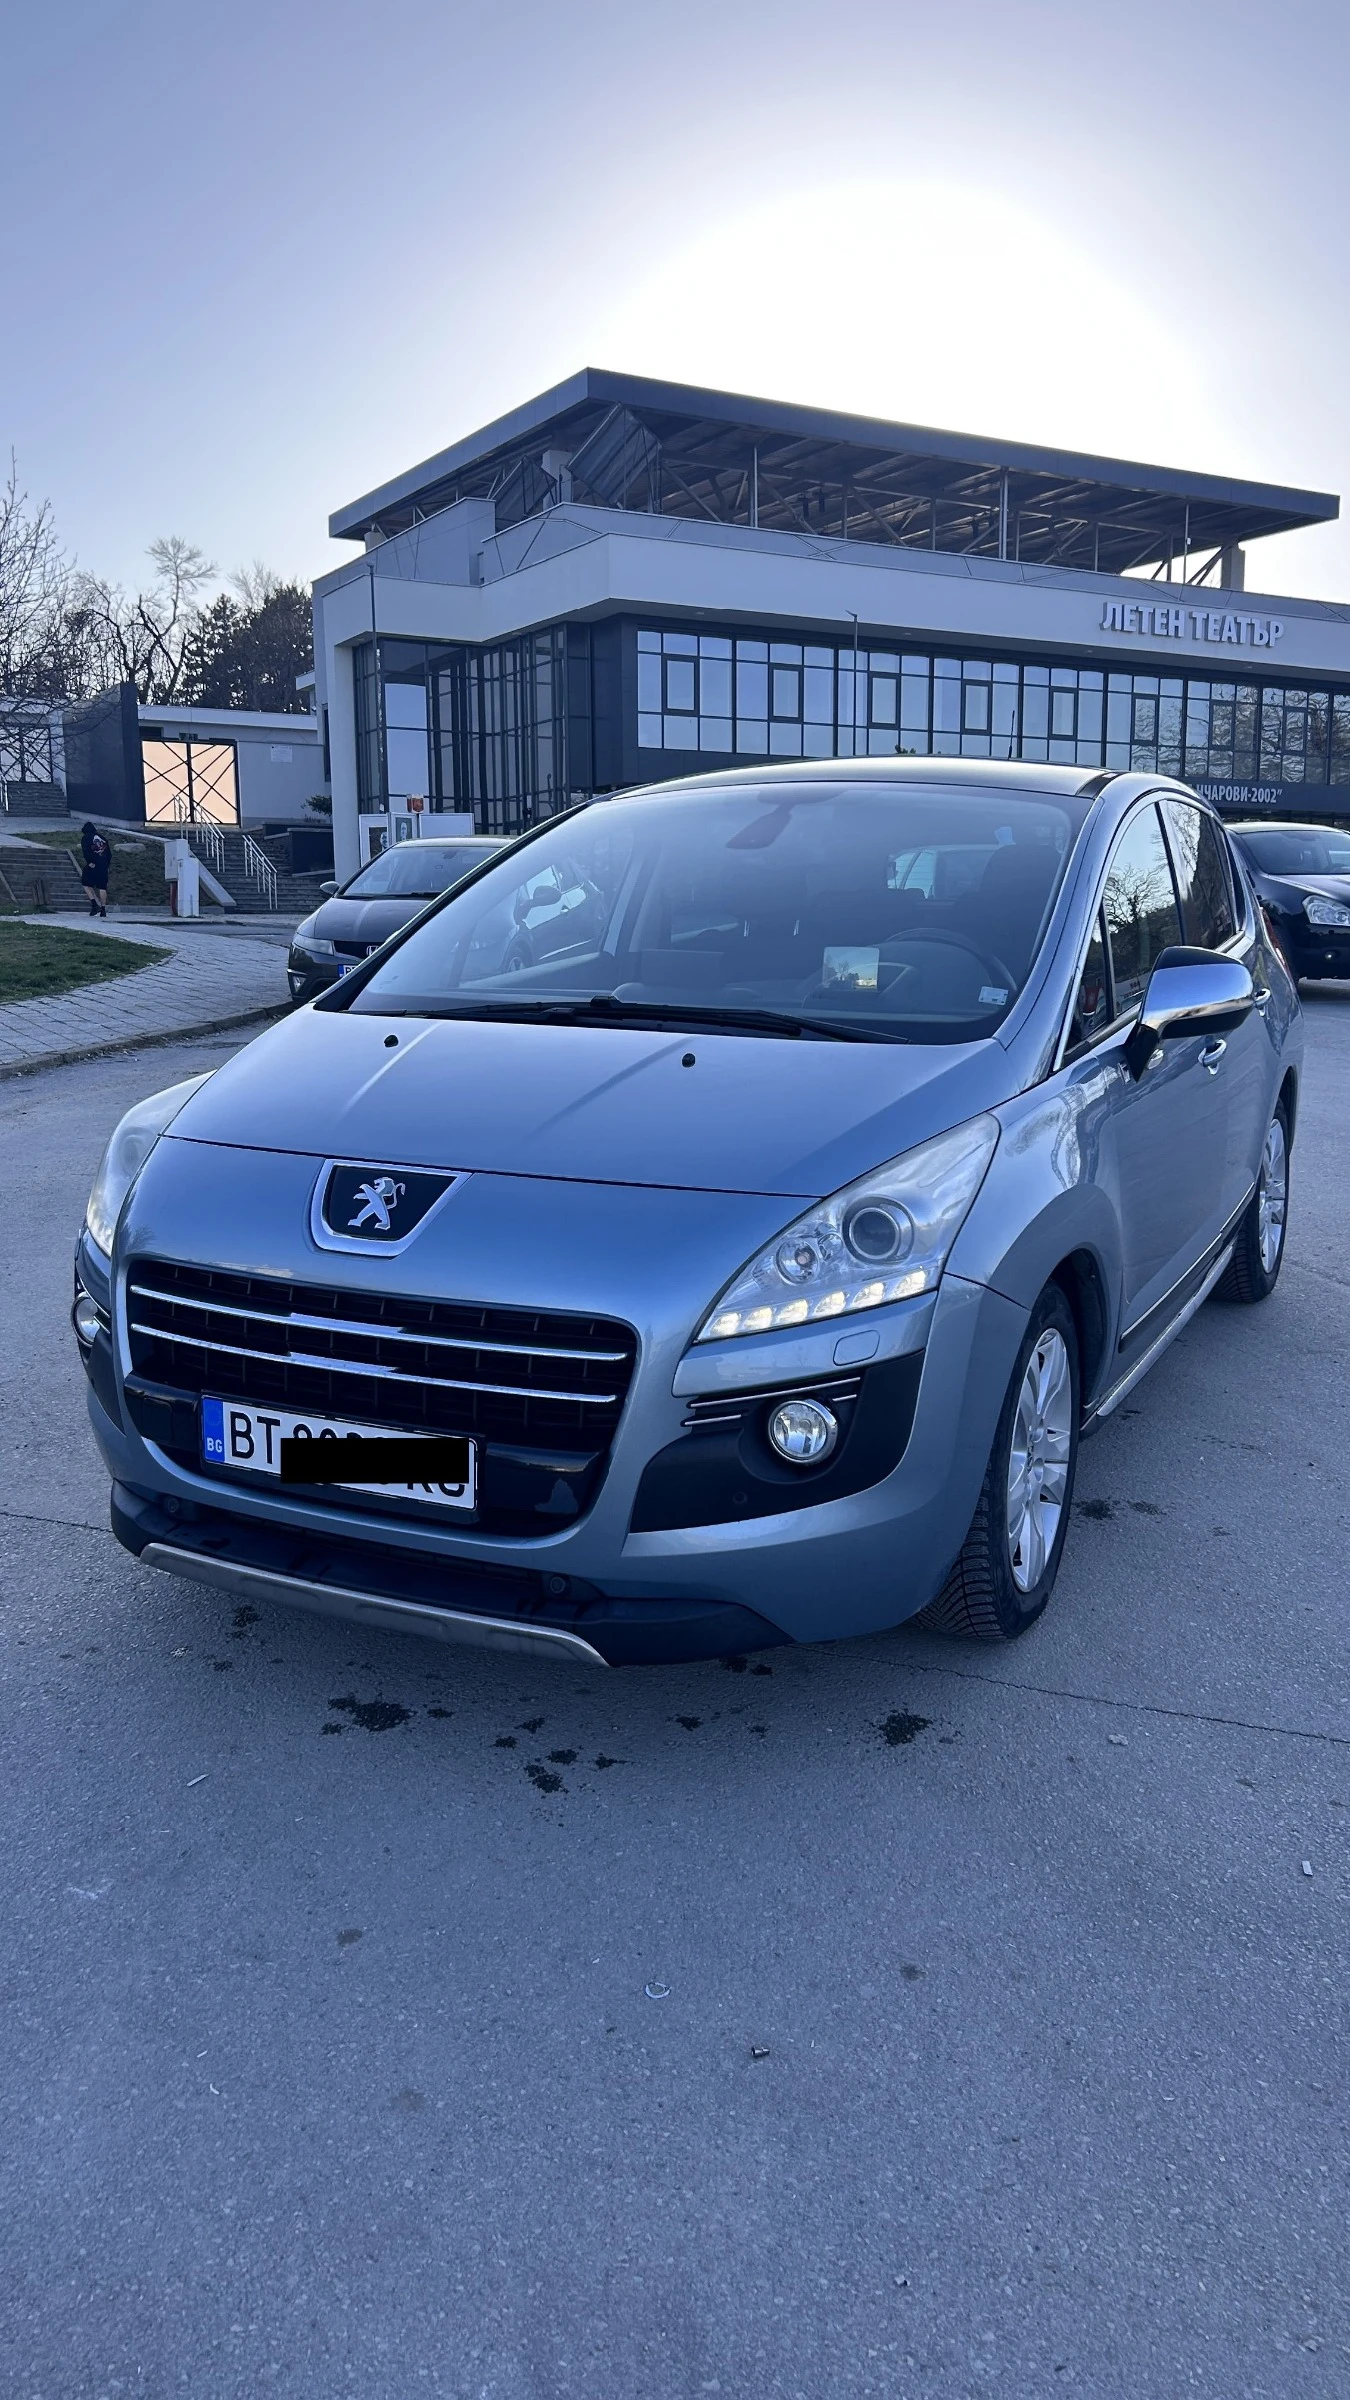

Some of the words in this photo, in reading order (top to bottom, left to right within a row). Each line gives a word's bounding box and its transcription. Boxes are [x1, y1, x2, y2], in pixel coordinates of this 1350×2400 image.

[1102, 602, 1185, 637] ЛЕТЕН
[1192, 612, 1285, 647] ТЕАТЪР
[1187, 784, 1282, 803] НЧАРОВИ-2002"
[206, 1437, 223, 1453] BG
[230, 1411, 281, 1465] BT
